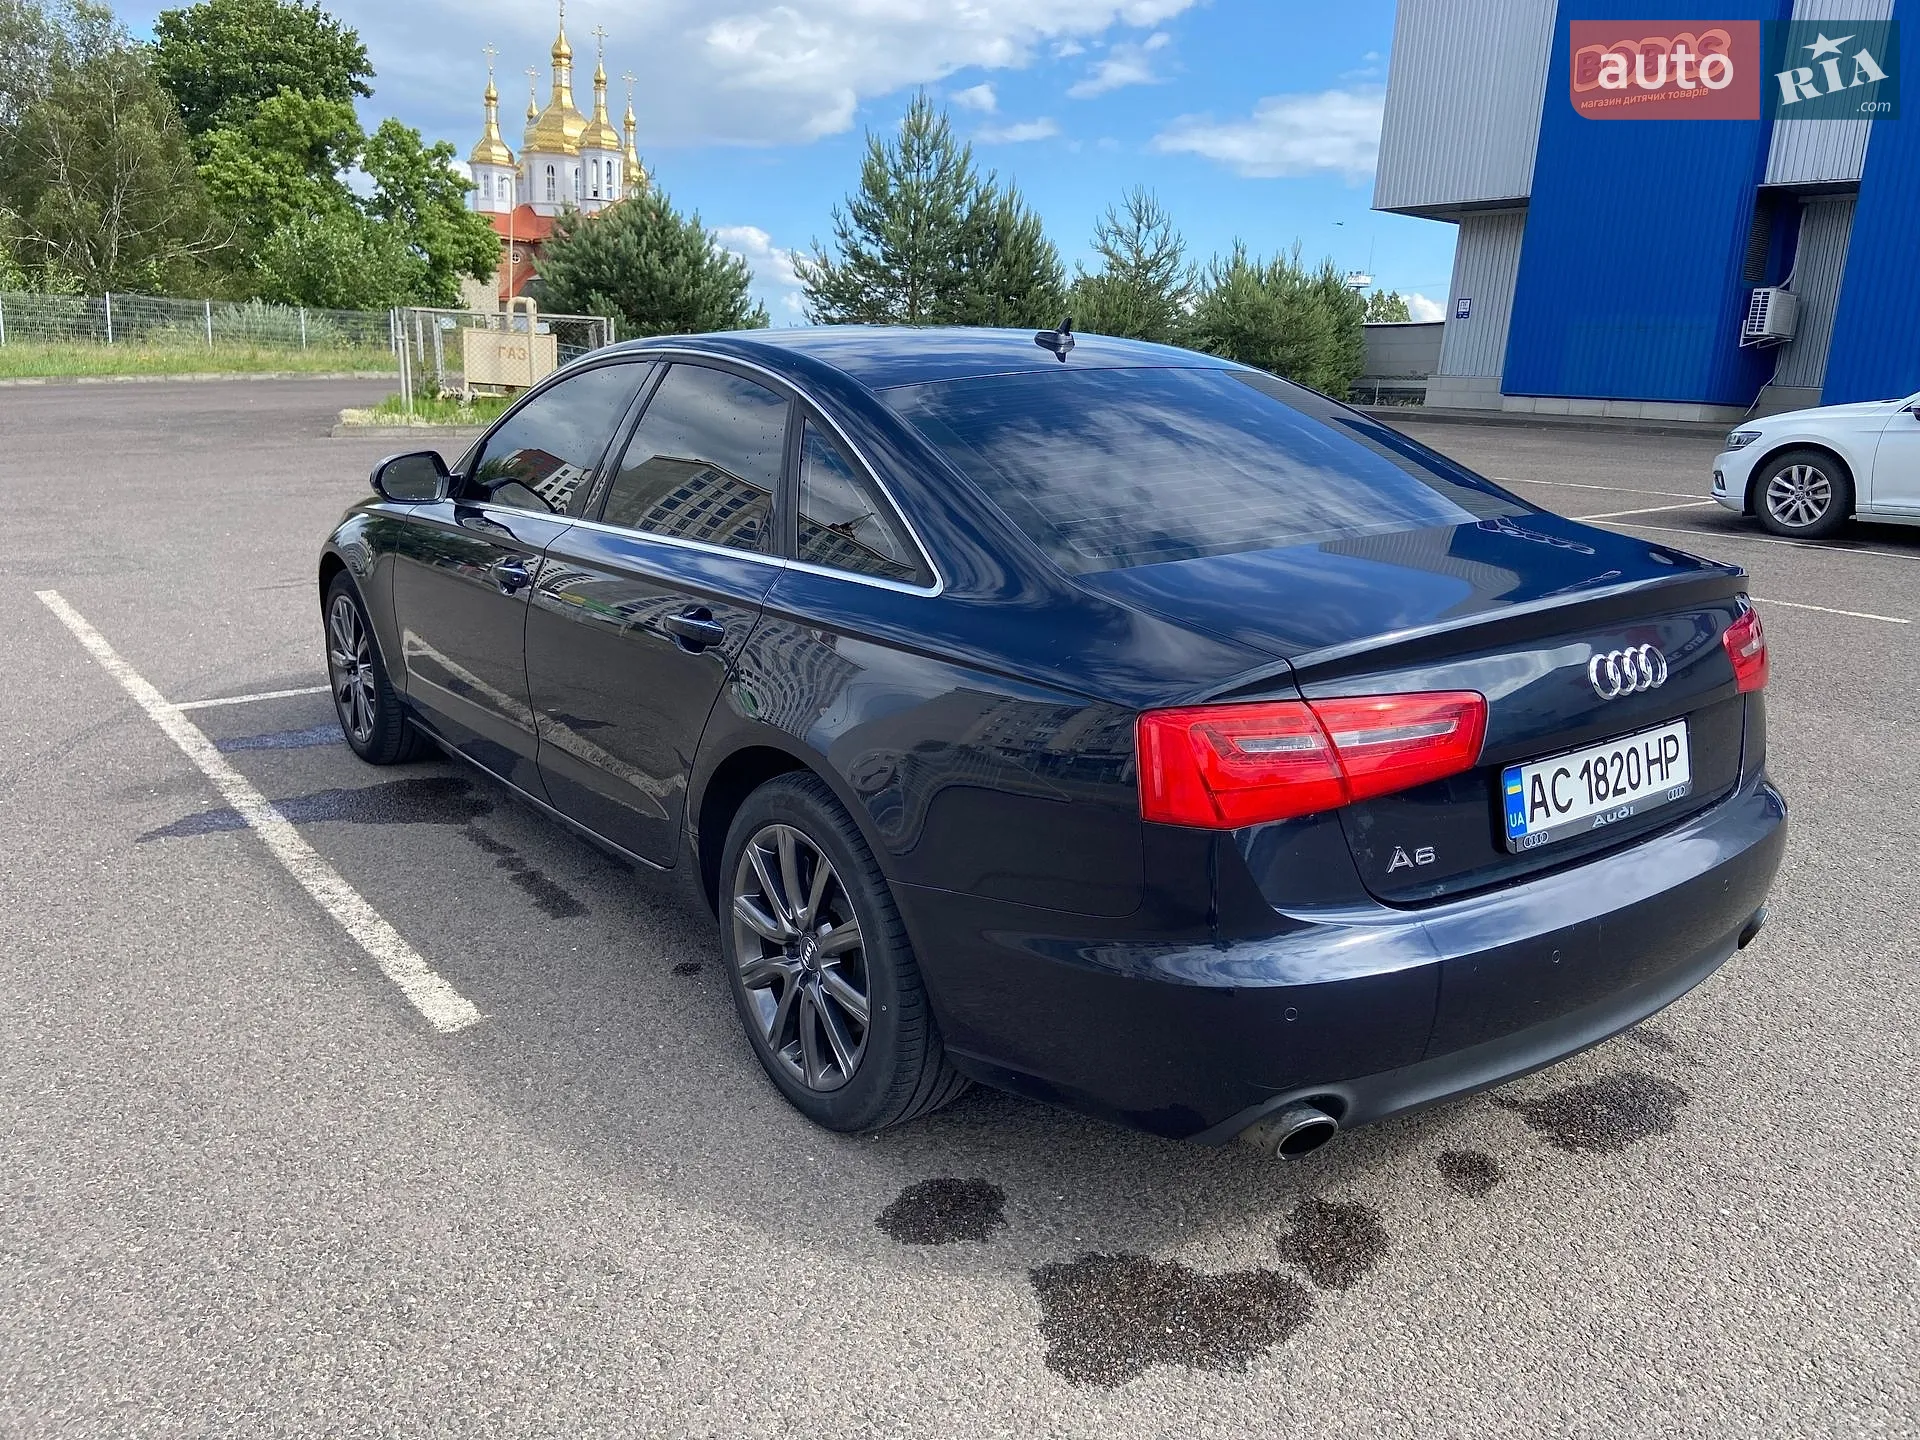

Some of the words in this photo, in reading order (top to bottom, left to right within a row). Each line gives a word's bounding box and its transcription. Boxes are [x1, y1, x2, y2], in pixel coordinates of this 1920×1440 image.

[1580, 97, 1622, 109] магазин
[1623, 92, 1666, 106] дитячих
[1667, 86, 1709, 99] товарів
[498, 346, 528, 361] ГАЗ
[1529, 767, 1574, 824] AC
[1579, 746, 1641, 804] 1820
[1645, 733, 1680, 786] HP
[1510, 814, 1525, 828] UA
[1592, 806, 1634, 829] Audi
[1386, 846, 1436, 873] A6
